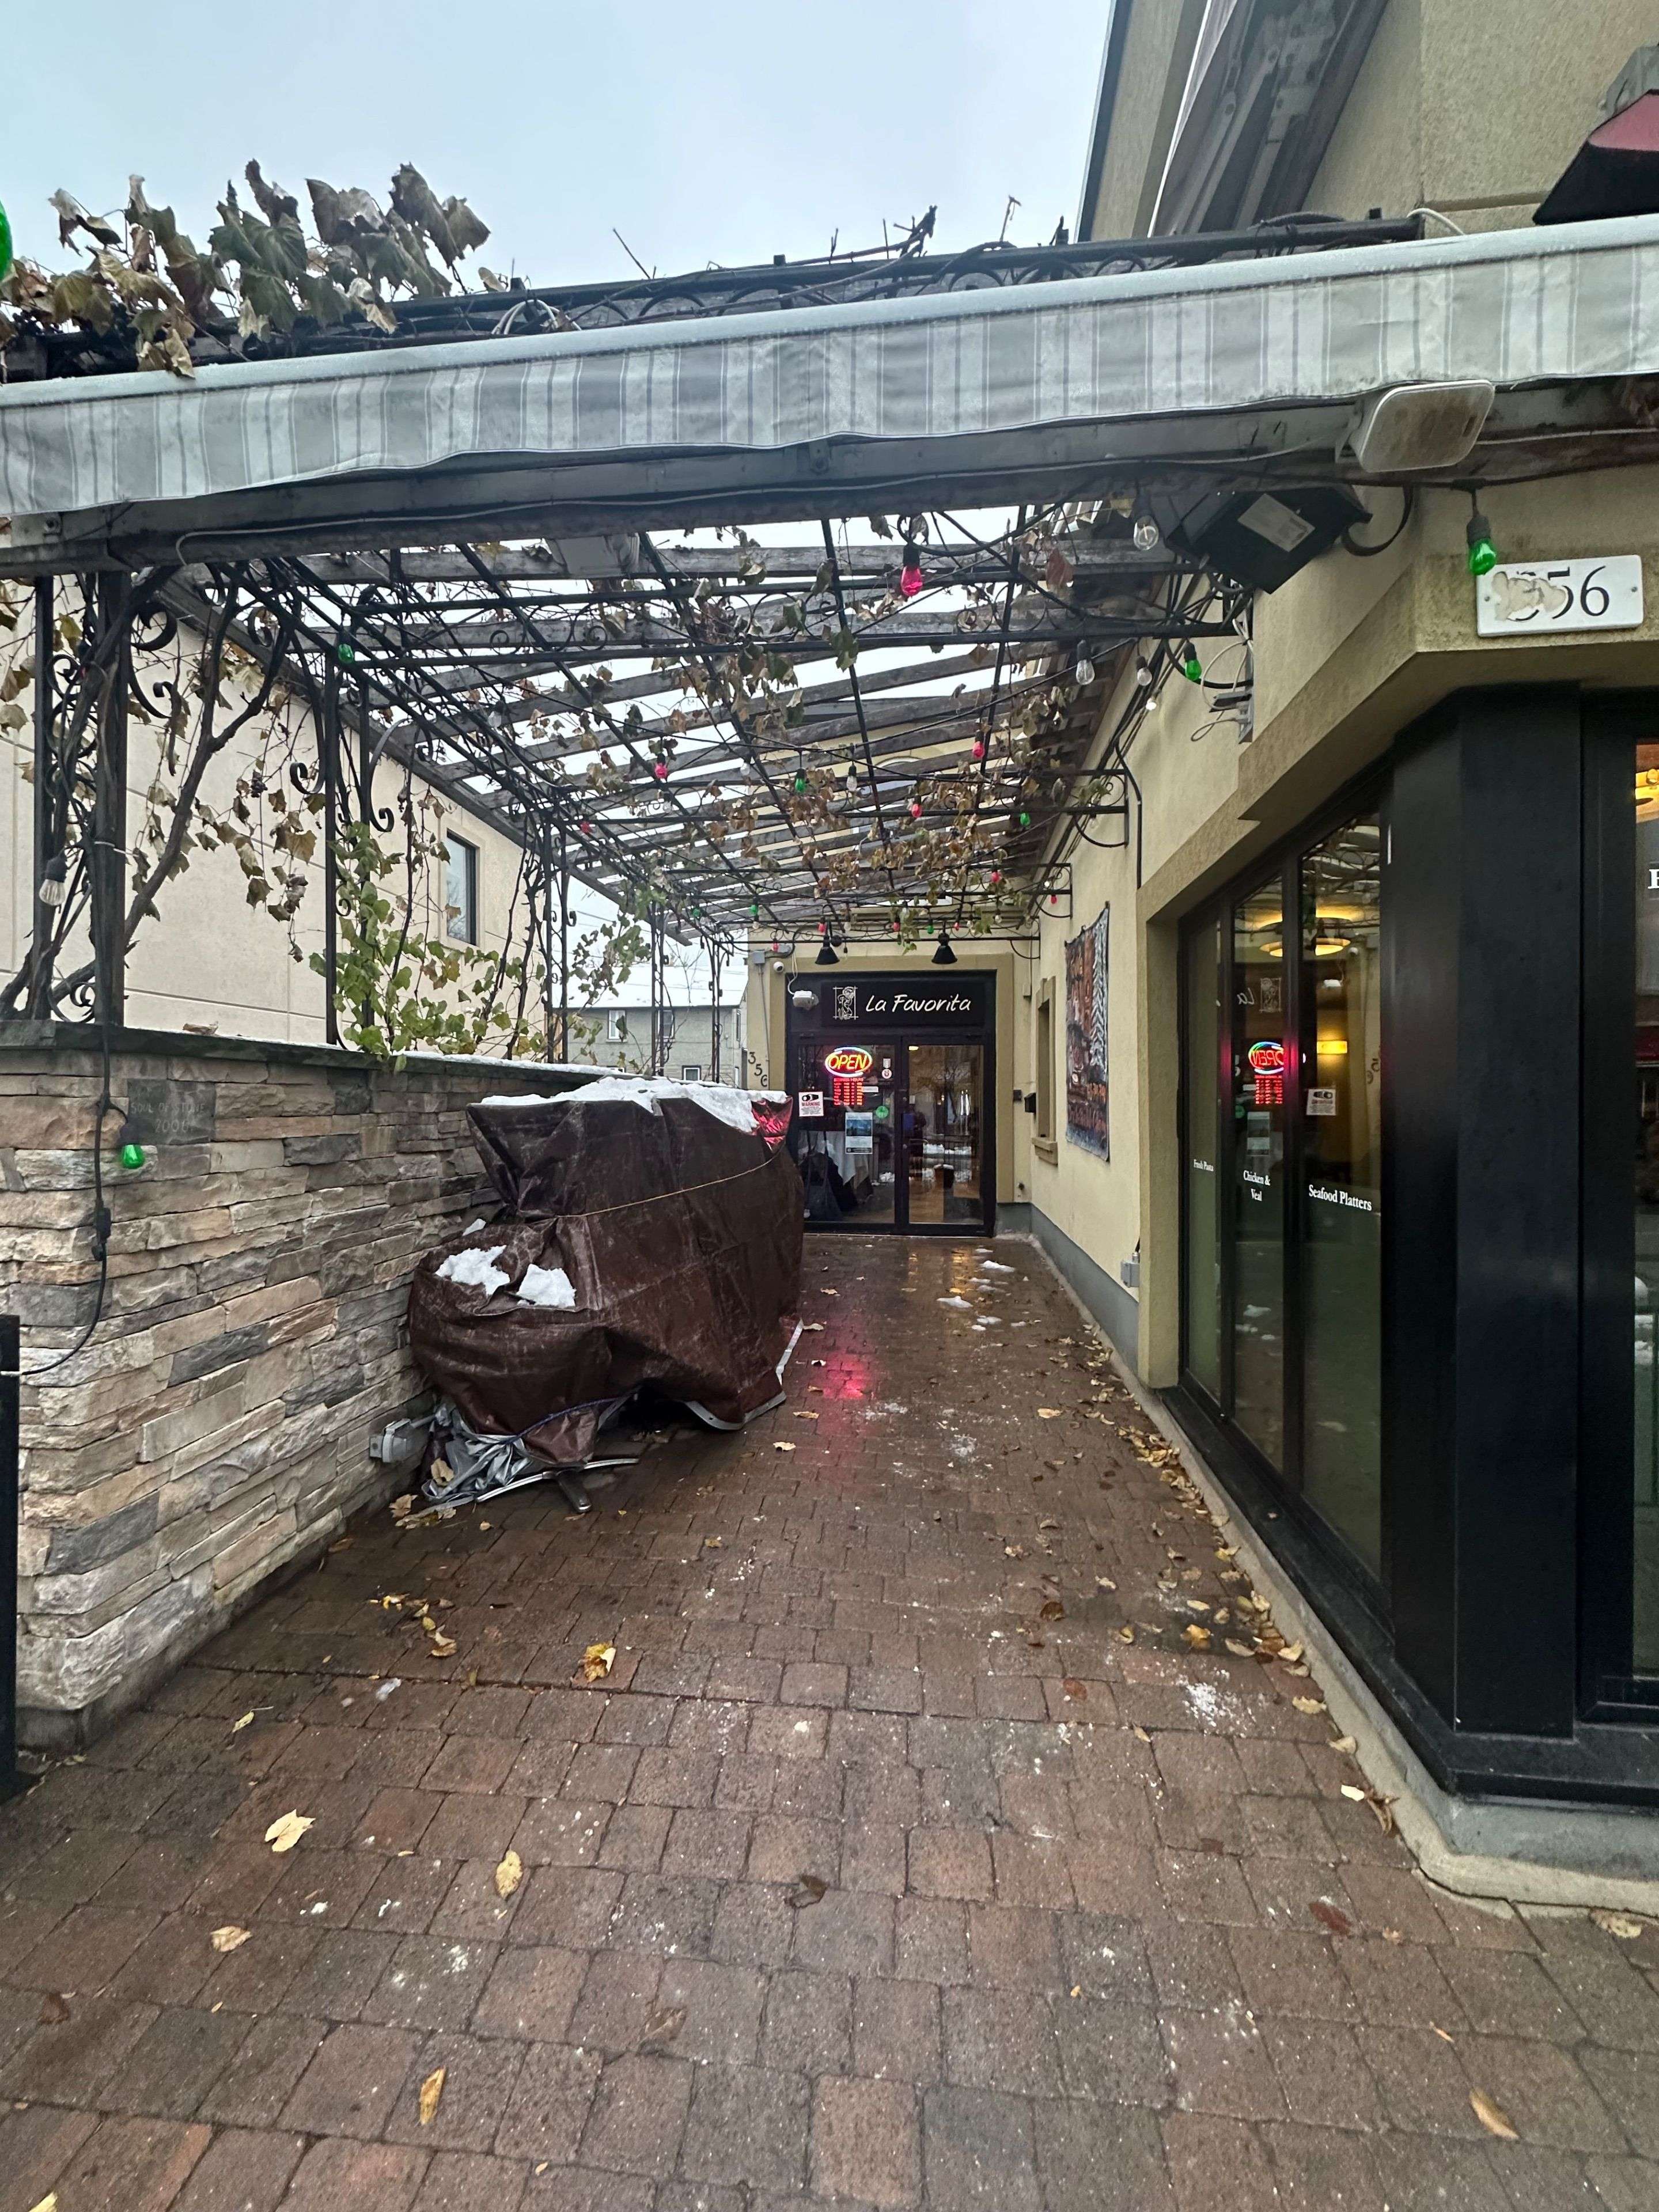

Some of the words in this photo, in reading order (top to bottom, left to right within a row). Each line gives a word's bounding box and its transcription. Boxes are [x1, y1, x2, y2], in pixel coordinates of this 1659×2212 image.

[865, 995, 887, 1012] La
[892, 994, 971, 1013] Favorita
[828, 1054, 868, 1070] OPEN
[131, 1102, 154, 1114] SOUL
[173, 1103, 206, 1116] STONE
[155, 1119, 189, 1133] 2006
[1243, 1169, 1264, 1184] Chicken
[1264, 1175, 1271, 1185] &
[1251, 1188, 1263, 1202] Veal
[1308, 1184, 1338, 1203] Seafood
[1339, 1191, 1372, 1211] Platters
